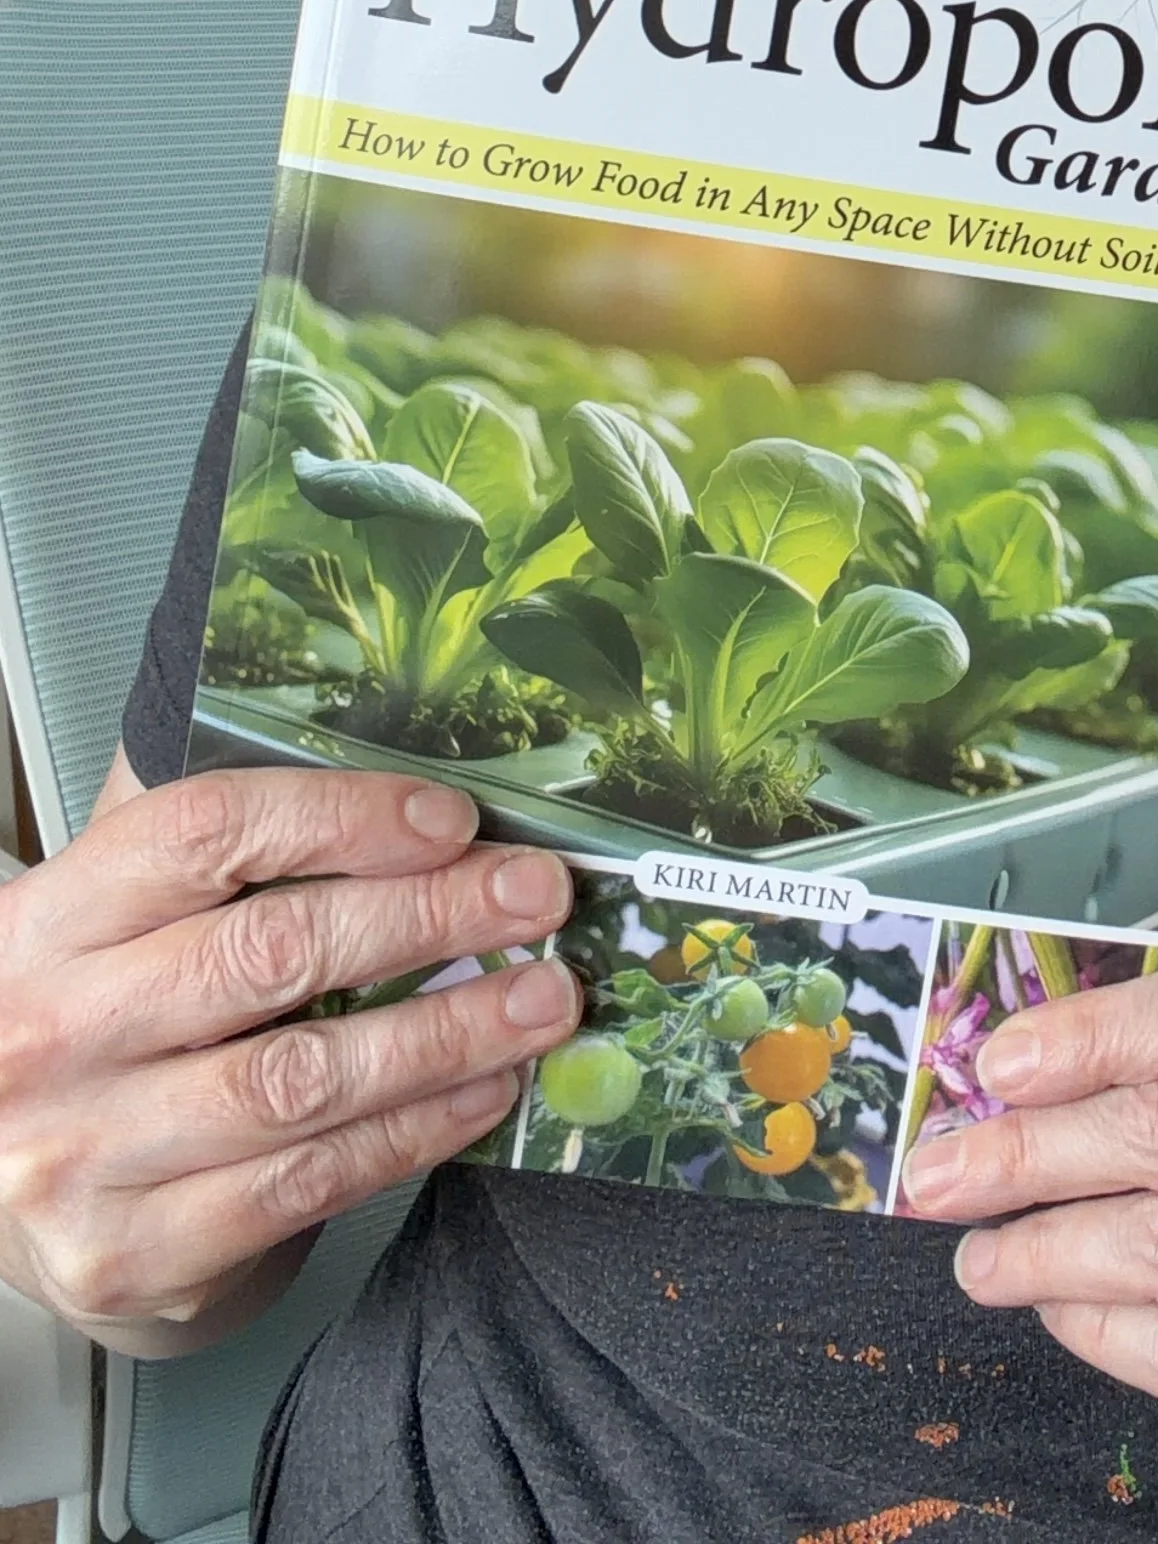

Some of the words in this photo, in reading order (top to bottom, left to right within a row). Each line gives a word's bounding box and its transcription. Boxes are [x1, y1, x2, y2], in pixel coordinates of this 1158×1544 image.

[338, 116, 425, 161] How
[435, 136, 470, 170] to
[481, 143, 584, 188] Grow
[592, 159, 688, 204] Food
[695, 177, 732, 212] in
[739, 184, 819, 233] Any
[827, 196, 931, 242] Space
[947, 213, 1092, 264] Without
[652, 863, 717, 893] KIRI
[726, 873, 853, 912] MARTIN
